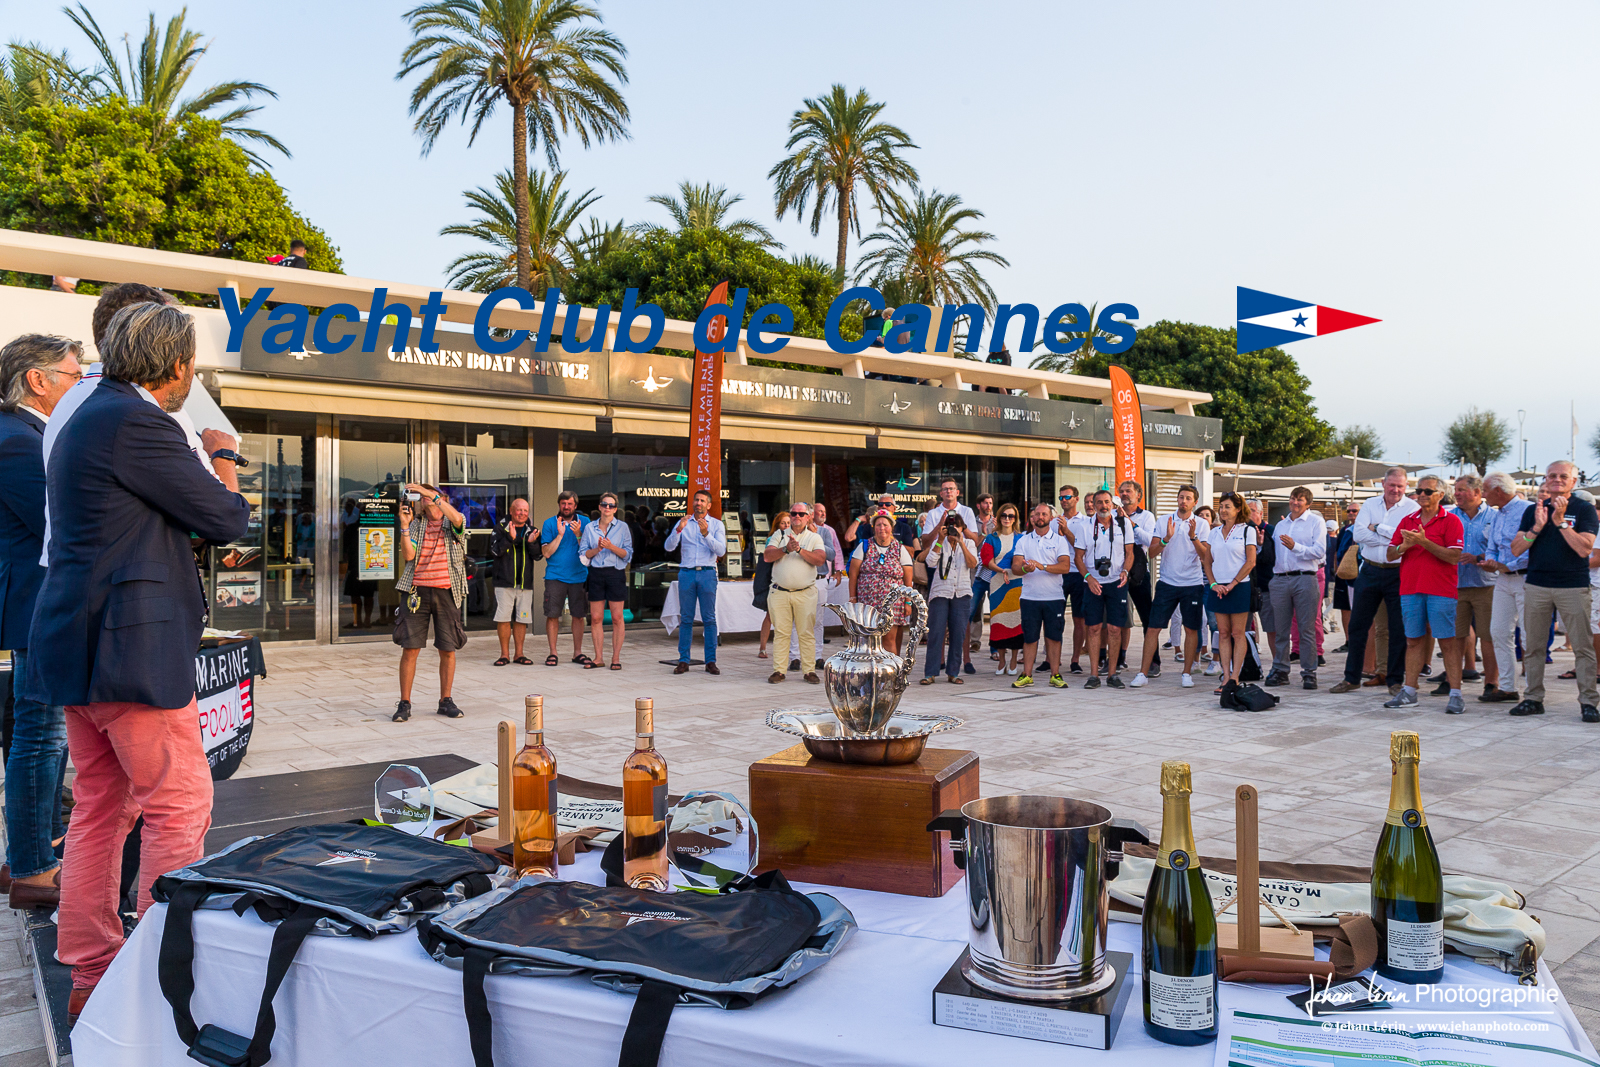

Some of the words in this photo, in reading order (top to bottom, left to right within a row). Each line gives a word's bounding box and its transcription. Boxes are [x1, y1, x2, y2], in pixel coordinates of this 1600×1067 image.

[387, 345, 463, 368] CANNES
[466, 347, 514, 372] BOAT
[519, 356, 589, 380] SERVICE
[721, 378, 763, 397] ANNES
[766, 382, 800, 400] BOAT
[802, 386, 852, 406] SERVICE
[1118, 390, 1132, 404] 06
[695, 356, 710, 492] ÉPARTEMENT
[978, 404, 1002, 420] BOAT
[1004, 406, 1041, 423] SERVICE
[636, 488, 670, 497] CANNES
[895, 494, 911, 502] BOAT
[195, 646, 250, 692] MARINE
[199, 702, 234, 737] POOL
[220, 746, 228, 761] OF
[229, 740, 239, 755] THE
[557, 812, 604, 820] CANNES
[1224, 885, 1300, 907] CANS
[1422, 1032, 1460, 1041] Dragon
